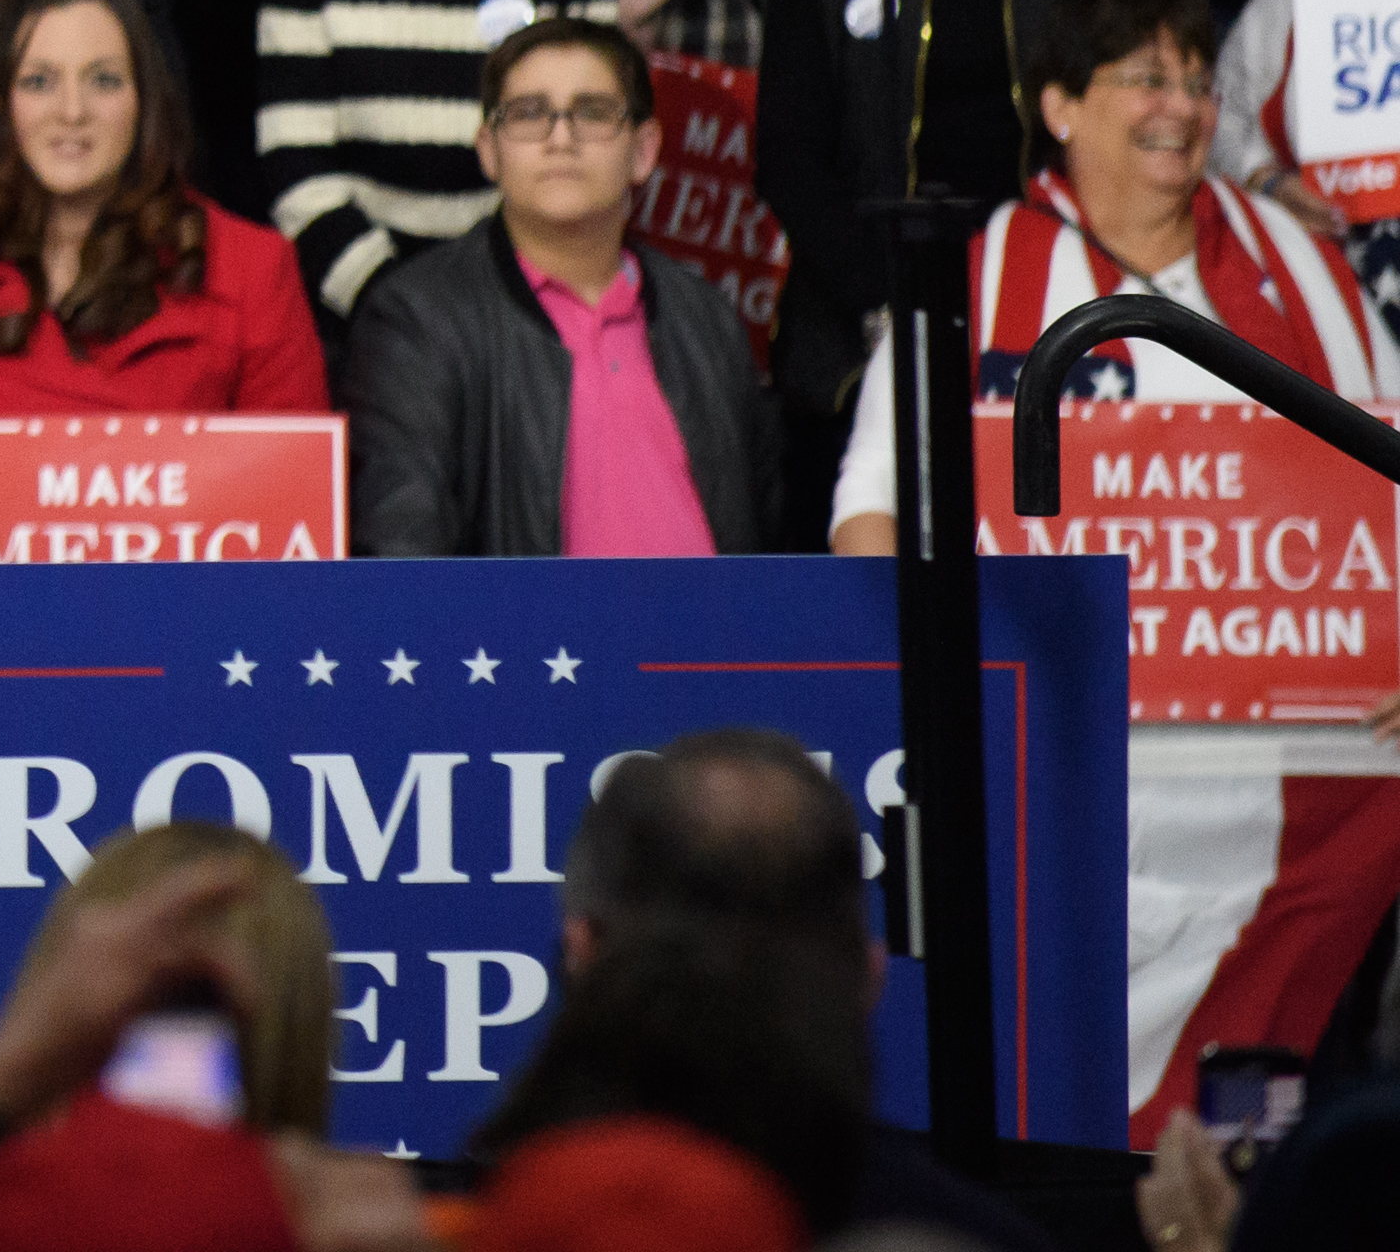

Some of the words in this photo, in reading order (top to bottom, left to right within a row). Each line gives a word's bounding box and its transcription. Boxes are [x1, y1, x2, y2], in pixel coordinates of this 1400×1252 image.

[37, 462, 189, 508] MAKE
[1092, 451, 1246, 501] MAKE
[1181, 604, 1368, 657] AGAIN
